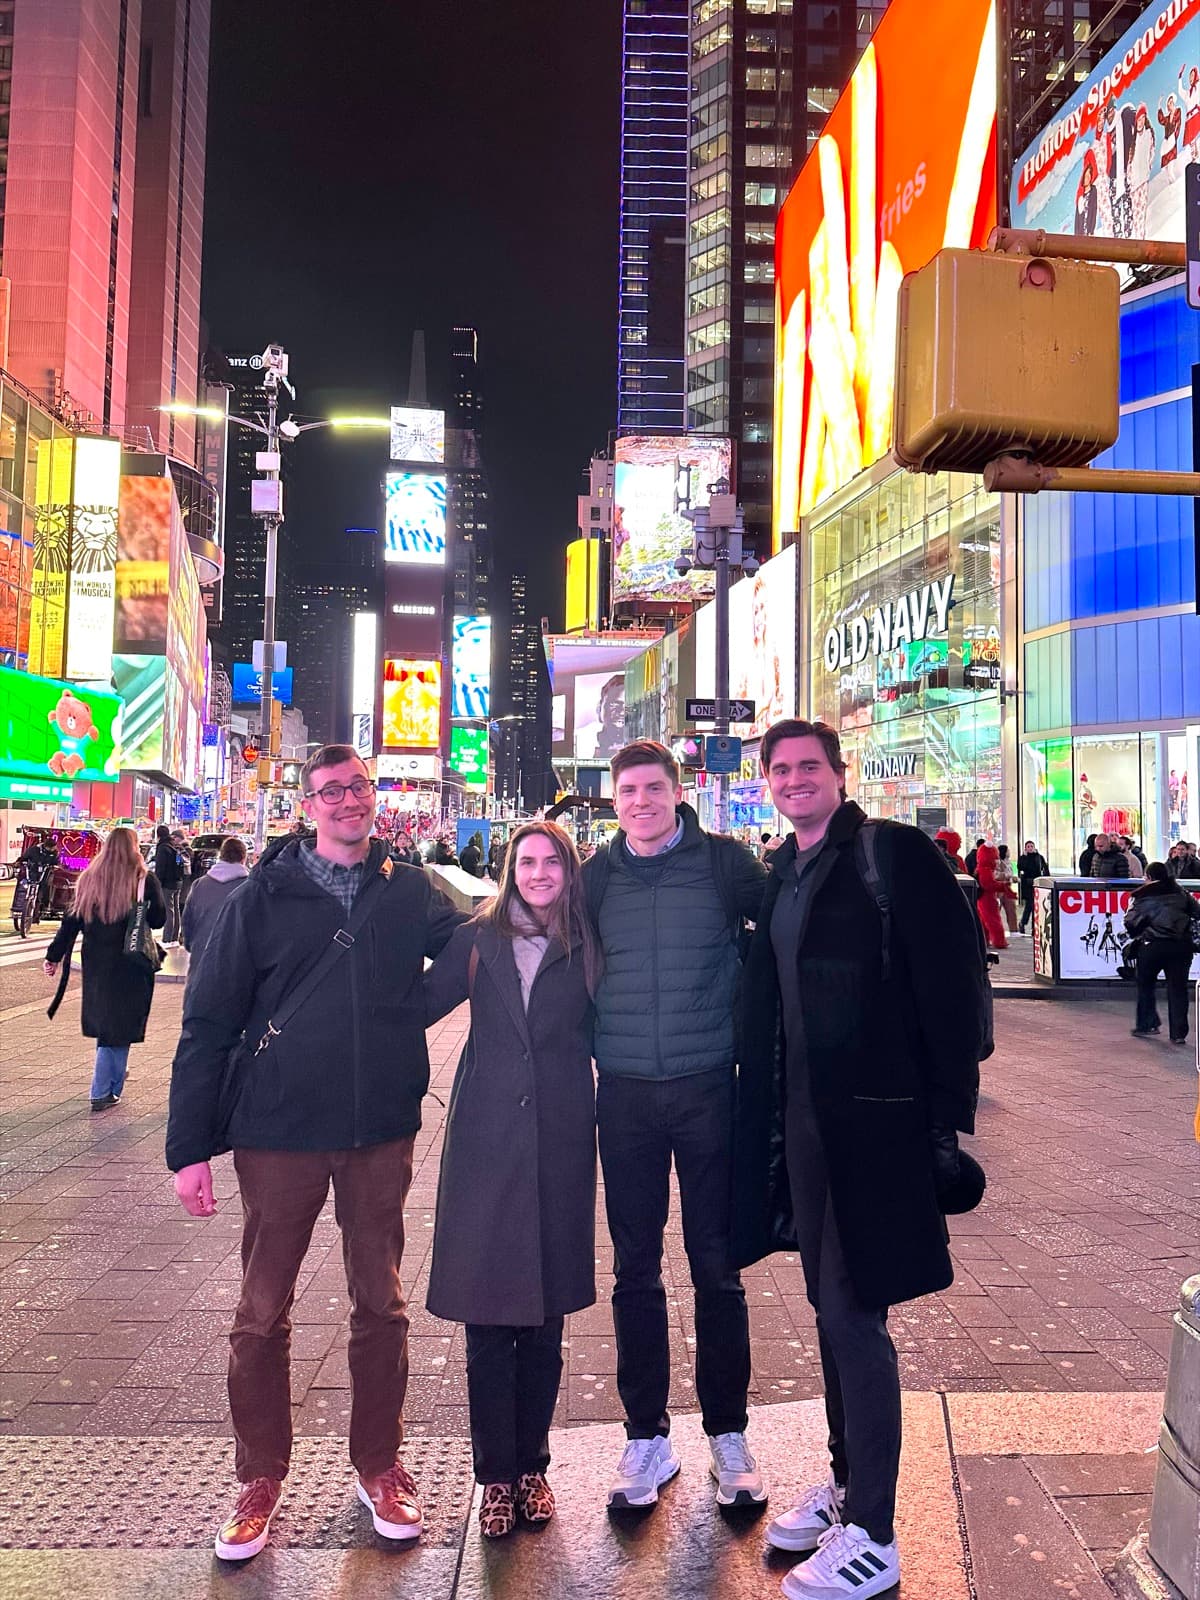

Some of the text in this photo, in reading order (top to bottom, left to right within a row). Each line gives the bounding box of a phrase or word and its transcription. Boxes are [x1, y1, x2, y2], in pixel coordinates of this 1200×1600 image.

[1023, 0, 1195, 187] Holiday Spectacu
[880, 161, 927, 241] fries
[80, 587, 112, 598] MUSICAL
[392, 604, 436, 615] SAMSUNG
[824, 615, 870, 673] OLD
[872, 573, 956, 656] NAVY
[695, 705, 744, 716] ONE AY
[863, 753, 916, 780] OLD NAVY
[1033, 887, 1041, 973] CHICAGO
